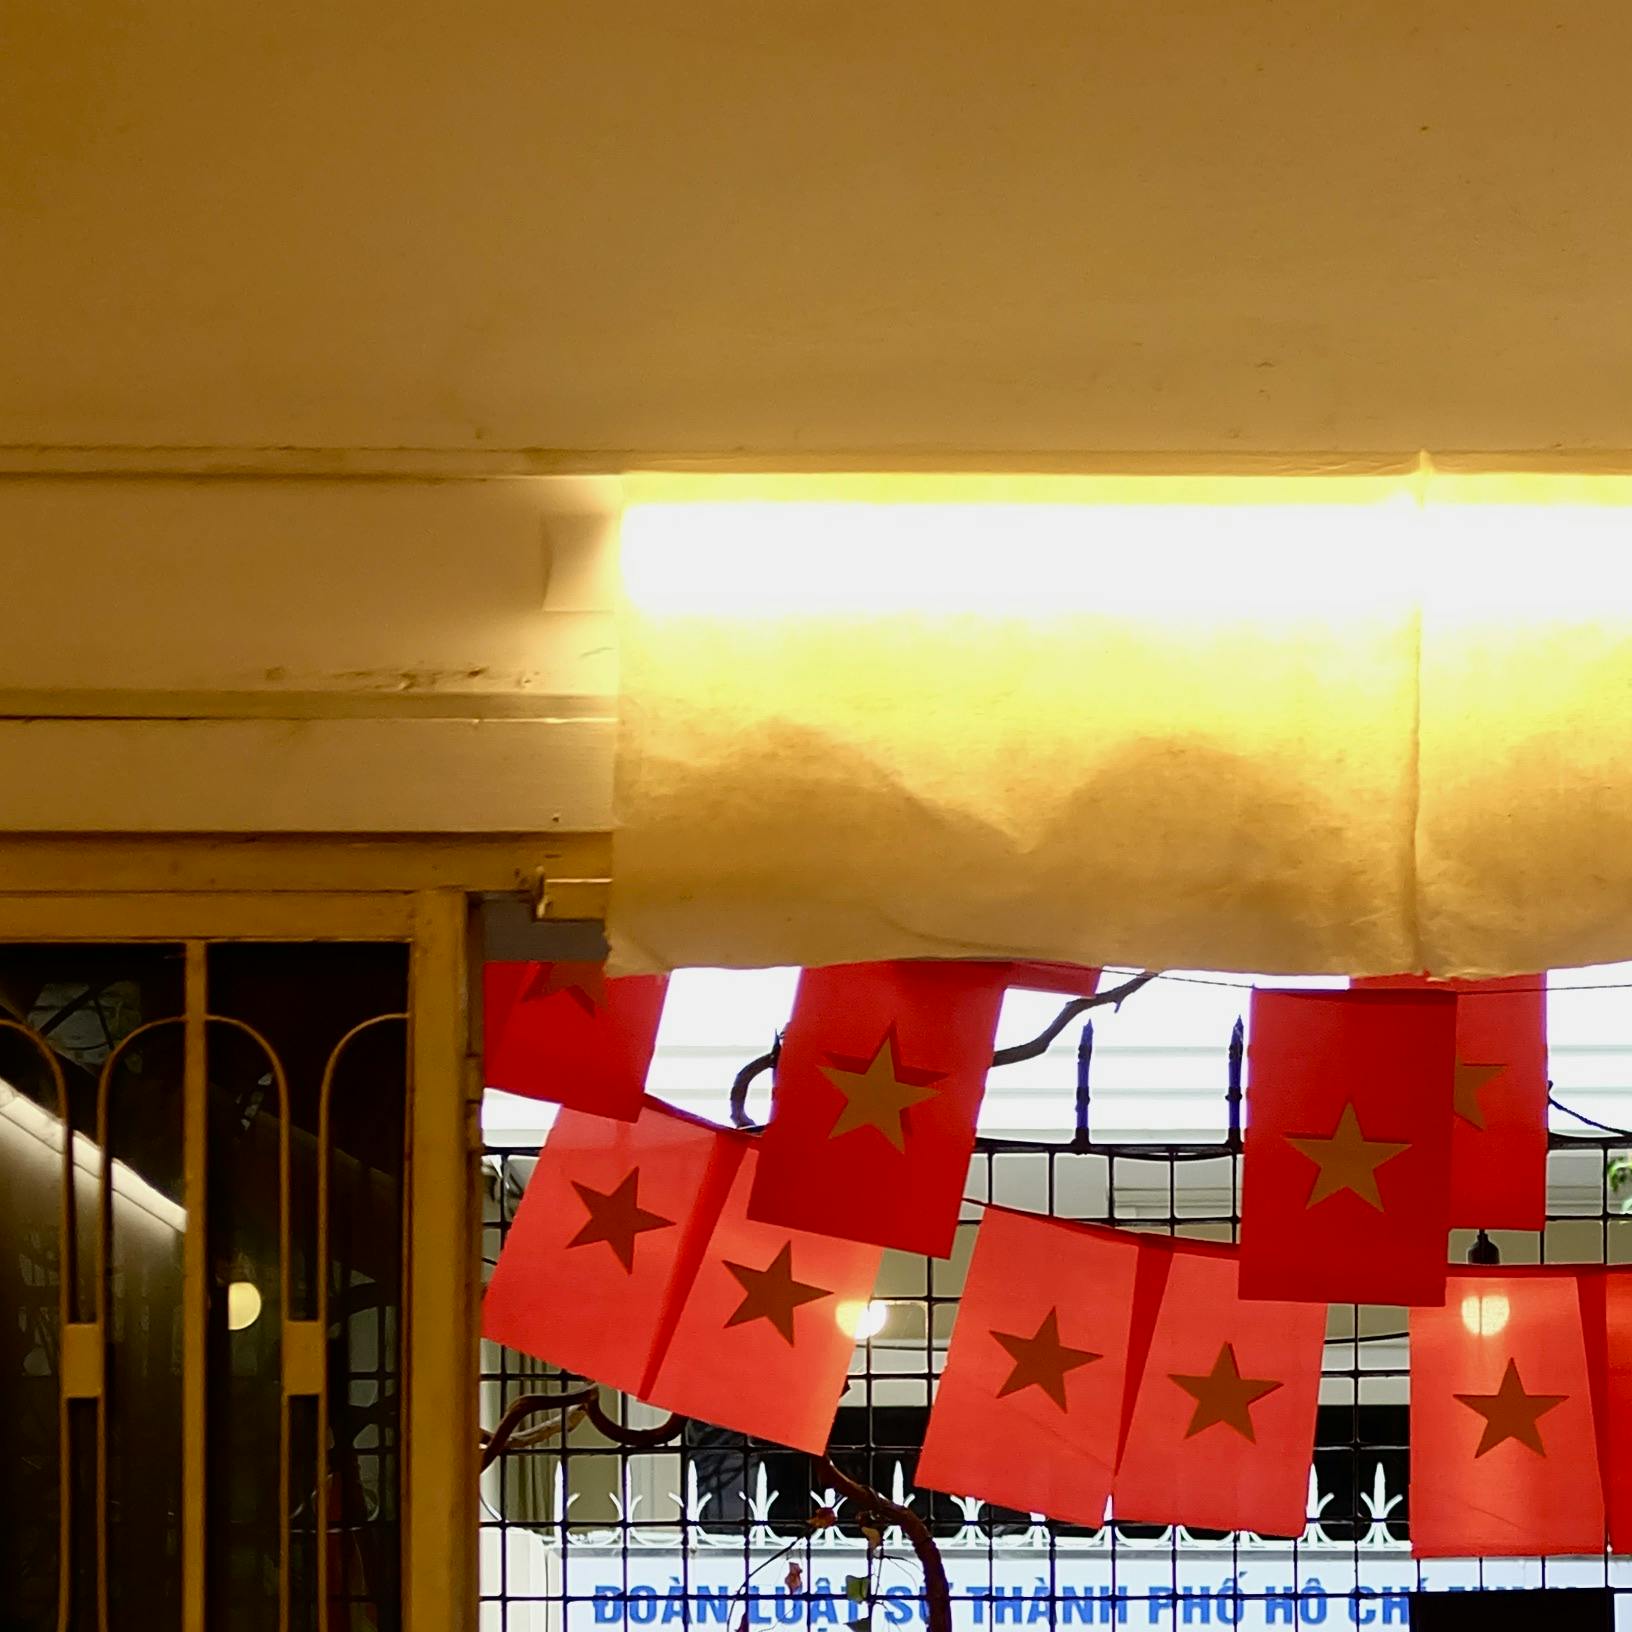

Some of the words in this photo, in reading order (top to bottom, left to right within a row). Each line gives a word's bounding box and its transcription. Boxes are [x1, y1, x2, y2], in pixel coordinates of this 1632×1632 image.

[591, 1576, 730, 1625] ĐOÀN
[966, 1576, 1129, 1625] THÀNH
[1148, 1571, 1248, 1626] PHỐ
[1347, 1577, 1429, 1626] CH
